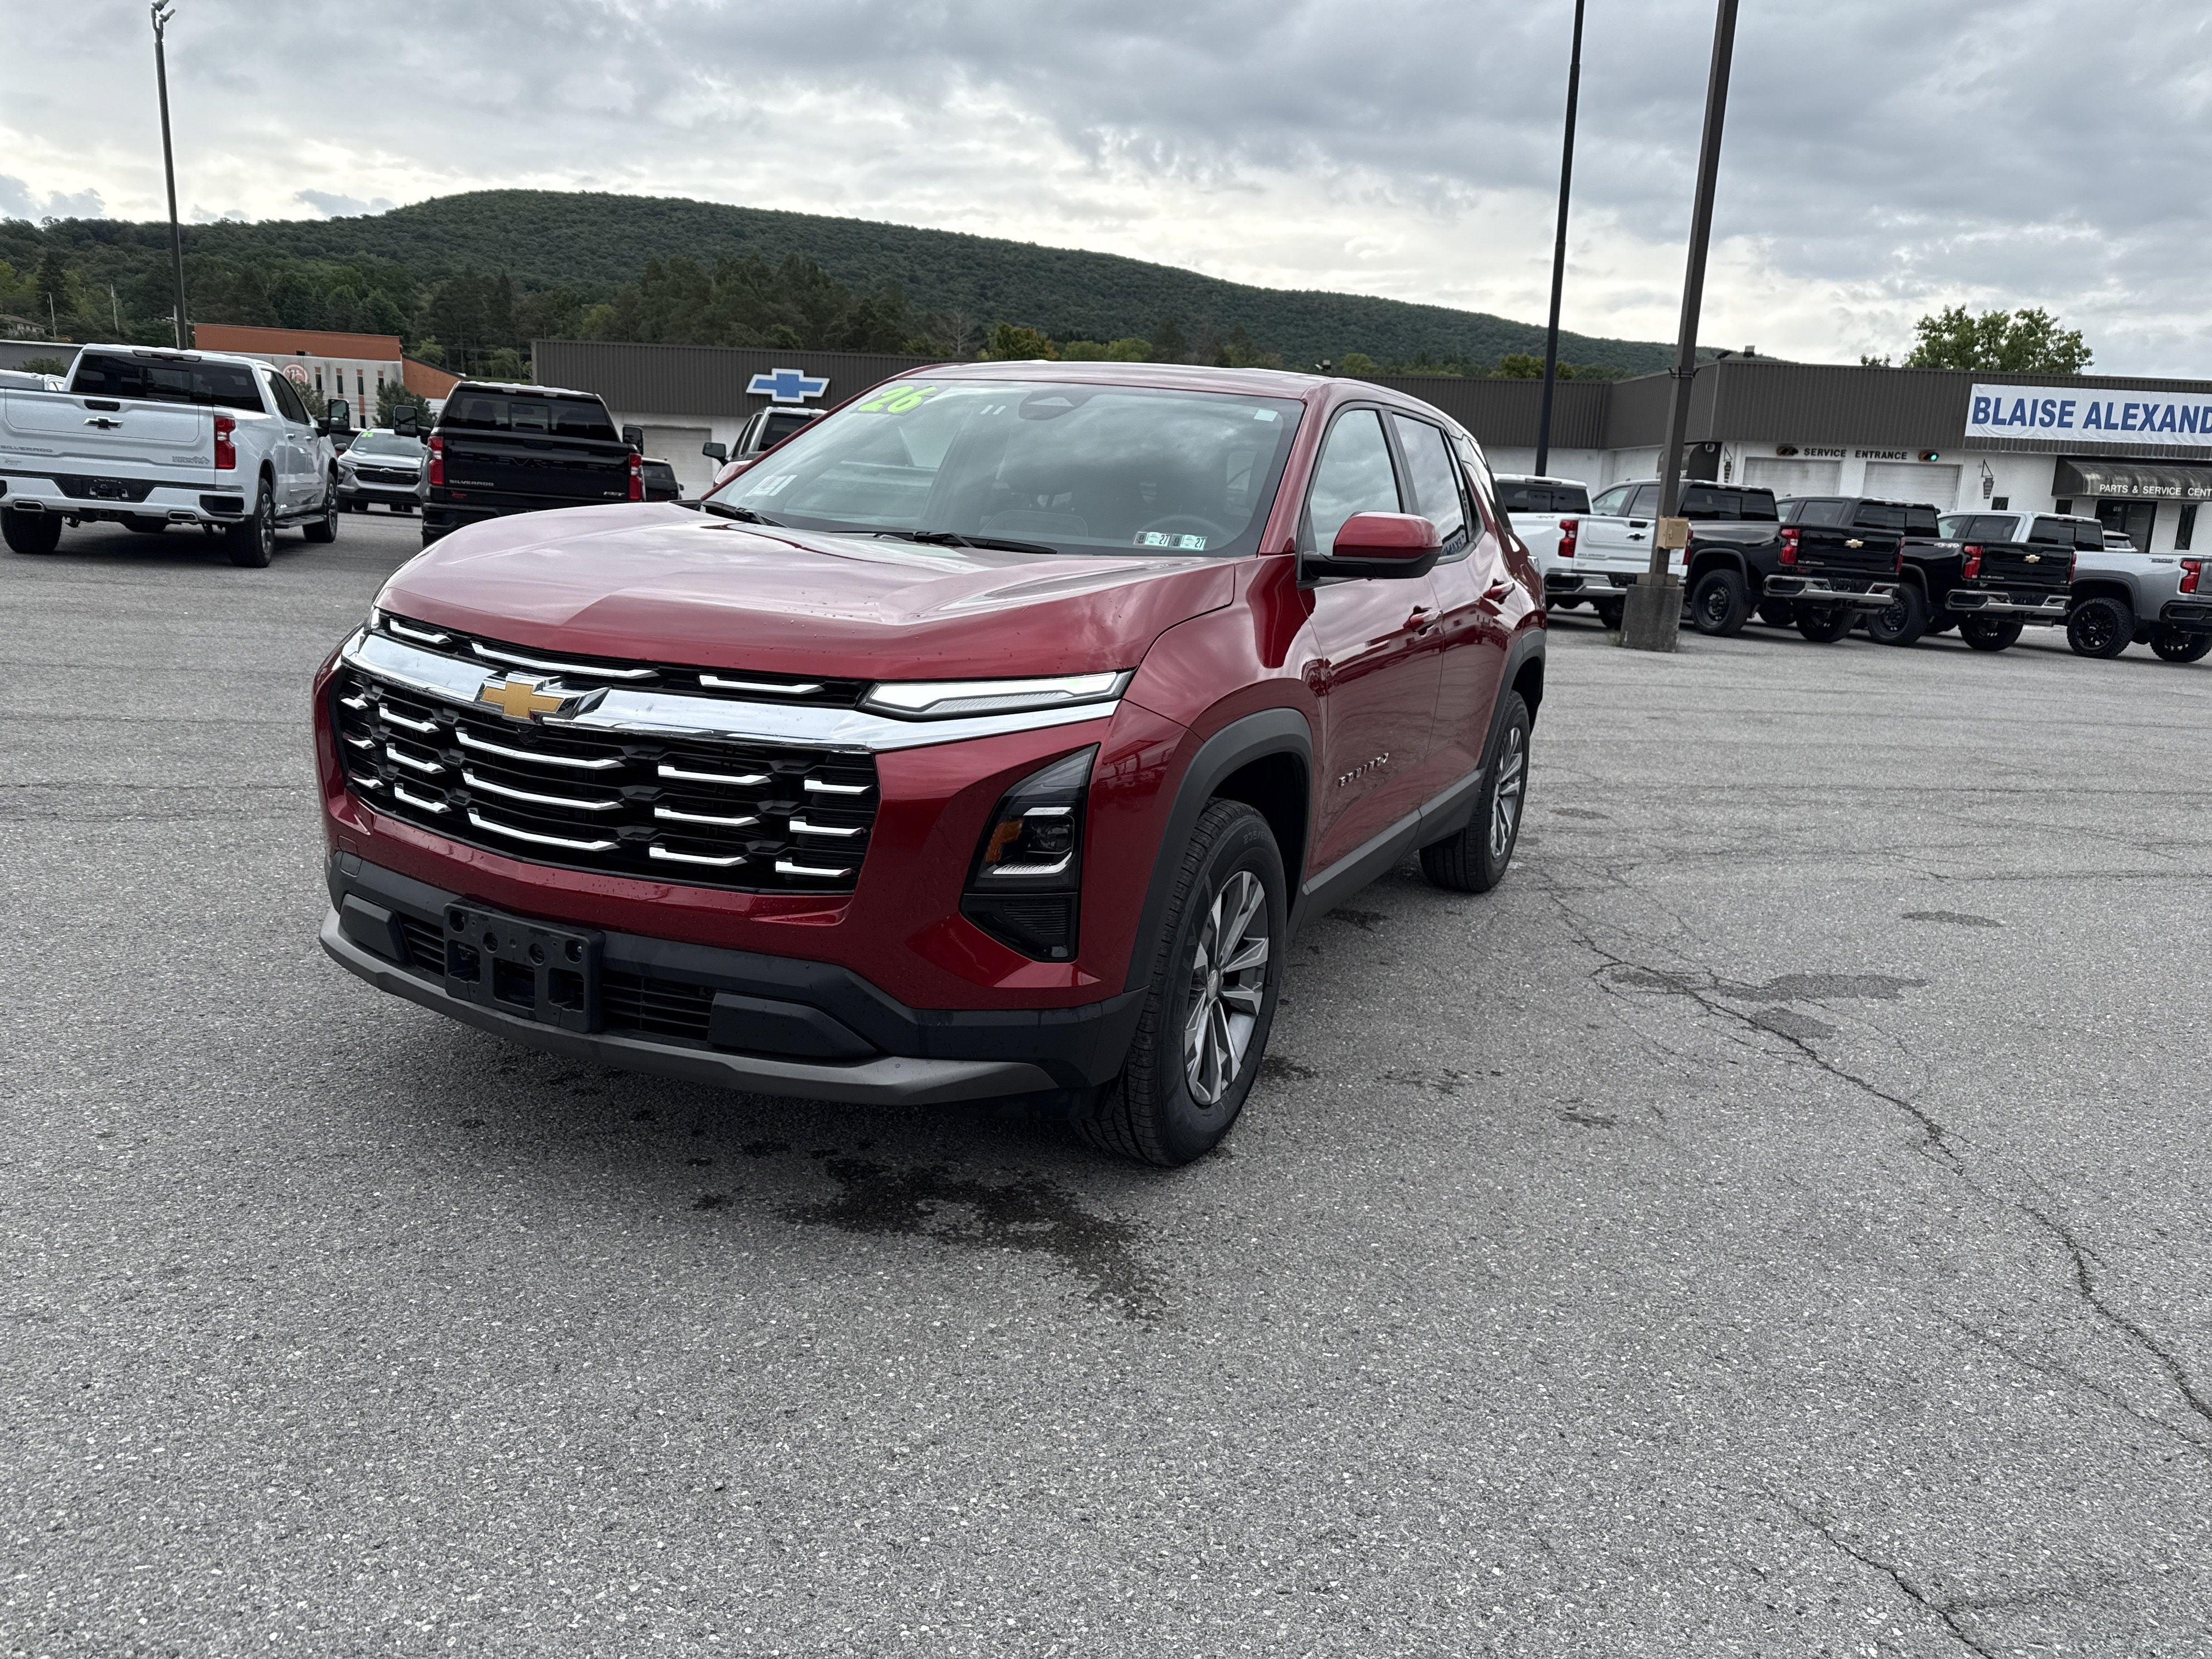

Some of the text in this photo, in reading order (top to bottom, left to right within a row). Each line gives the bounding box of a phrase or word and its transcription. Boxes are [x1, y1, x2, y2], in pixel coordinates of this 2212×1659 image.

[858, 385, 937, 413] 26
[1972, 396, 2212, 434] BLAISE ALEXAND
[1804, 447, 1908, 460] SERVICE ENTRANCE
[2100, 484, 2129, 493] PARTS
[2132, 486, 2138, 494] &
[2142, 486, 2182, 496] SERVICE
[1159, 535, 1169, 545] 27
[1194, 538, 1205, 548] 27
